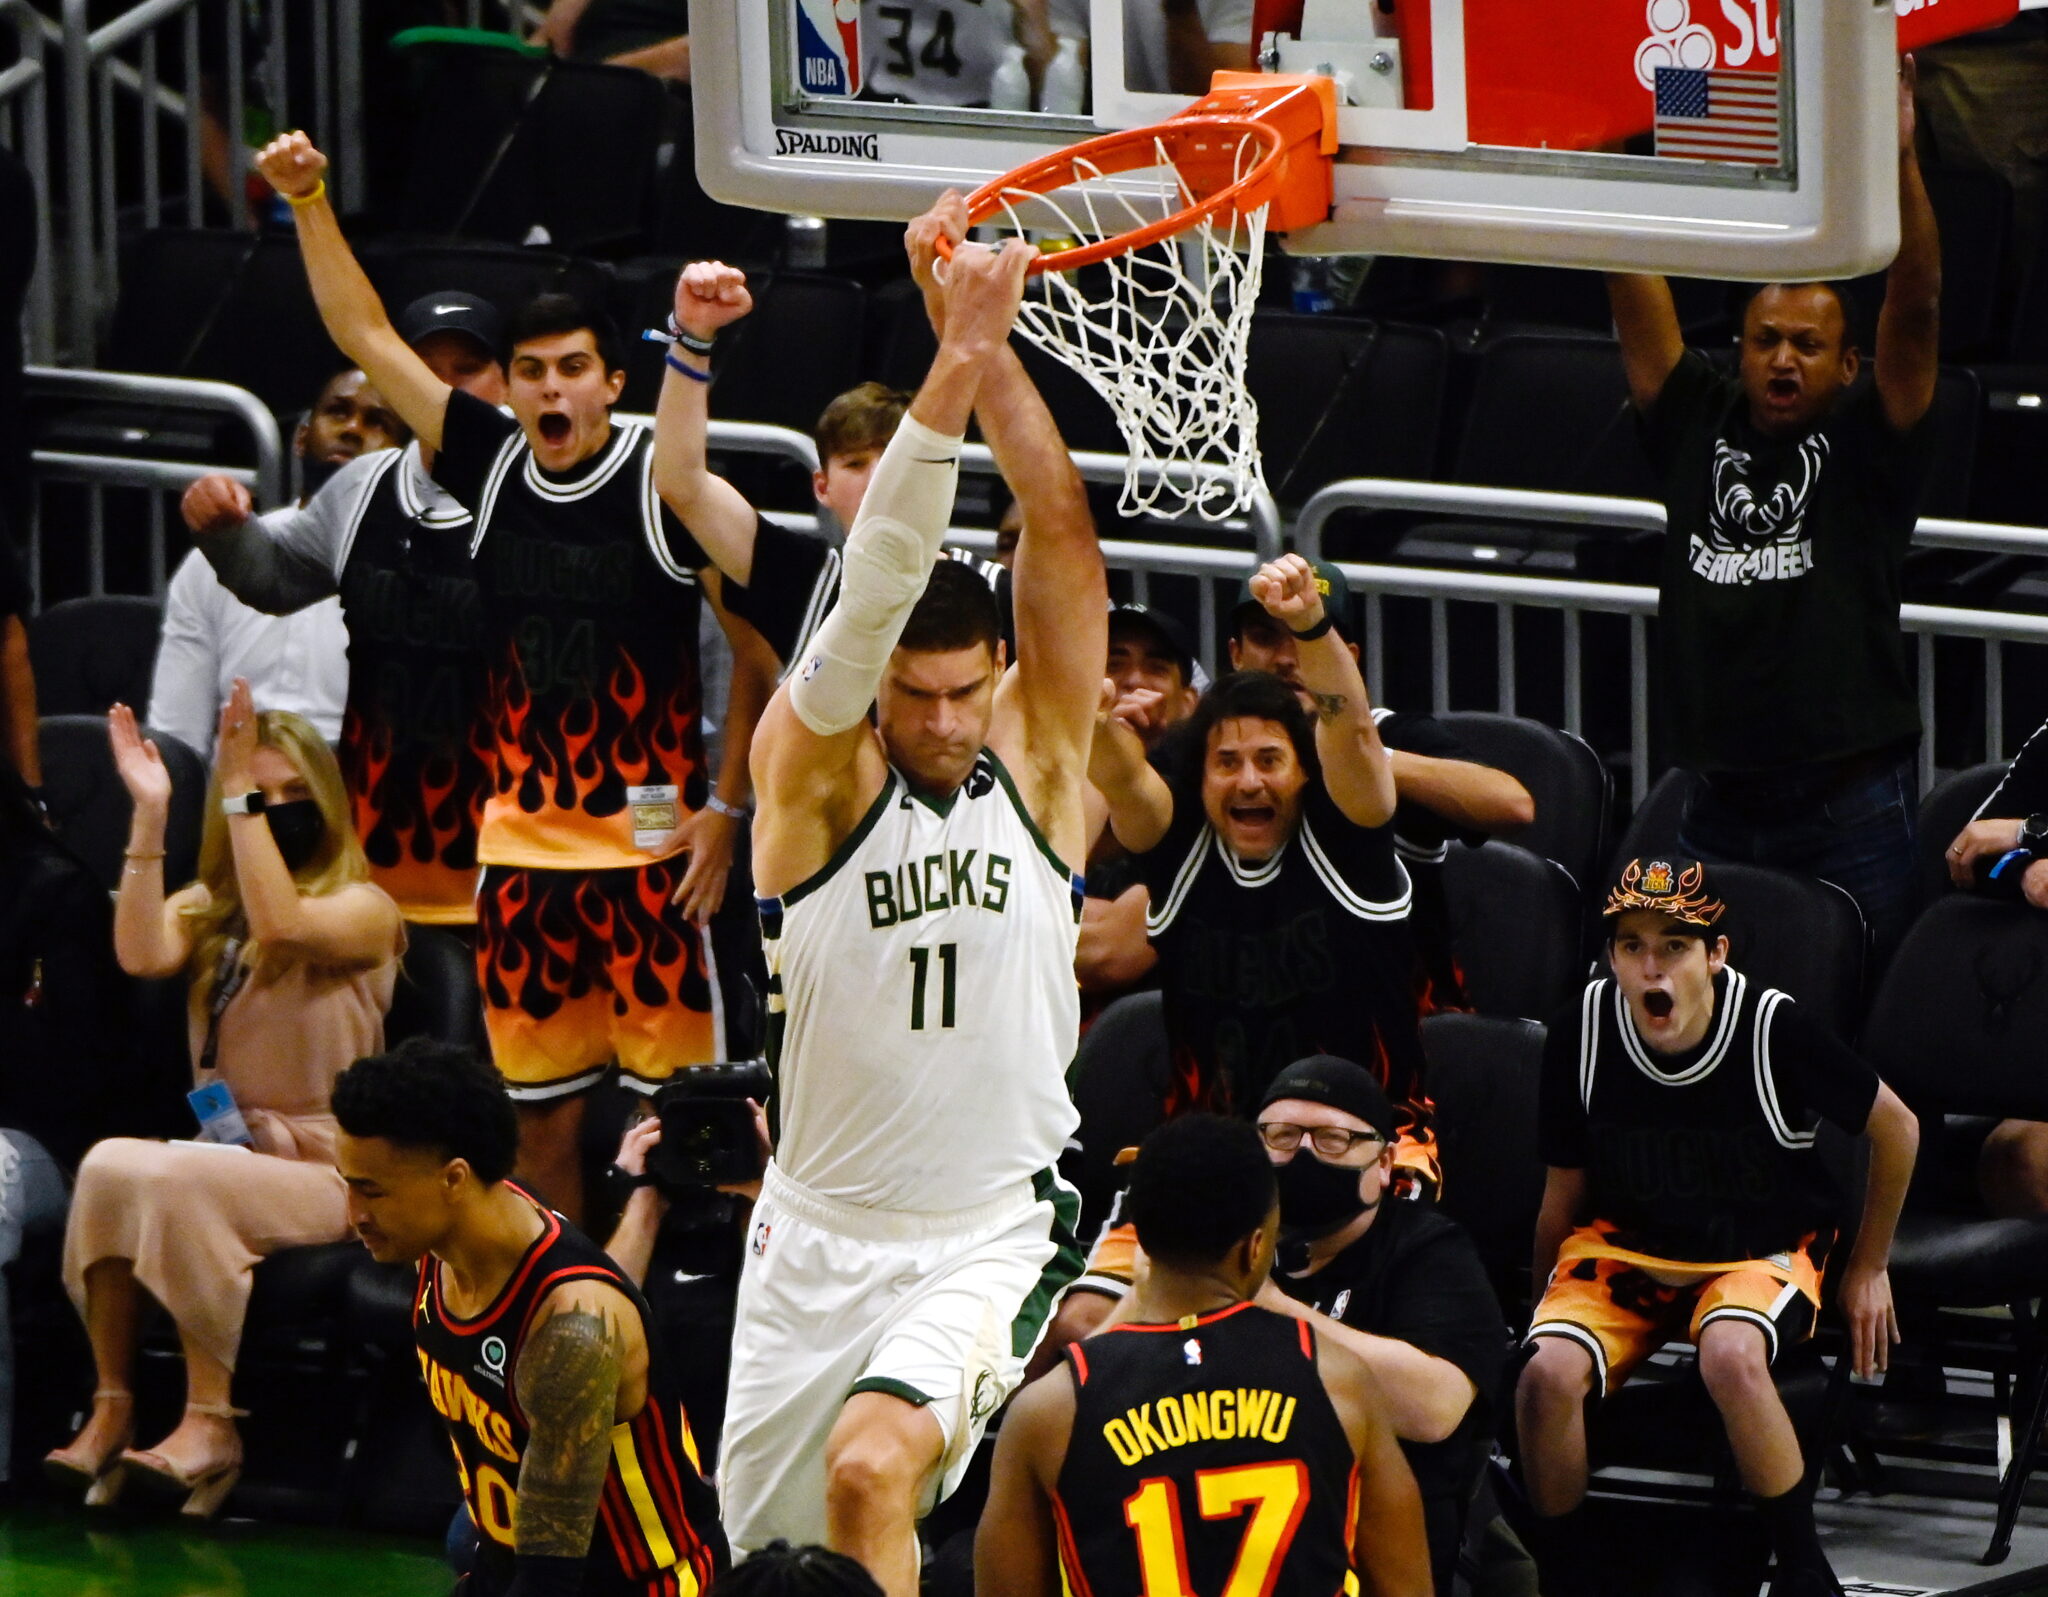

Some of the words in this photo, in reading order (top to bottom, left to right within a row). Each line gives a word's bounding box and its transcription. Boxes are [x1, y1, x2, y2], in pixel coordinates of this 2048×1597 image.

[879, 6, 962, 77] 34
[1721, 0, 1780, 67] St
[806, 57, 838, 86] NBA
[775, 128, 879, 161] SPALDING
[865, 849, 1012, 929] BUCKS
[910, 943, 957, 1030] 11
[1103, 1388, 1297, 1466] OKONGWU
[1123, 1459, 1311, 1597] 17
